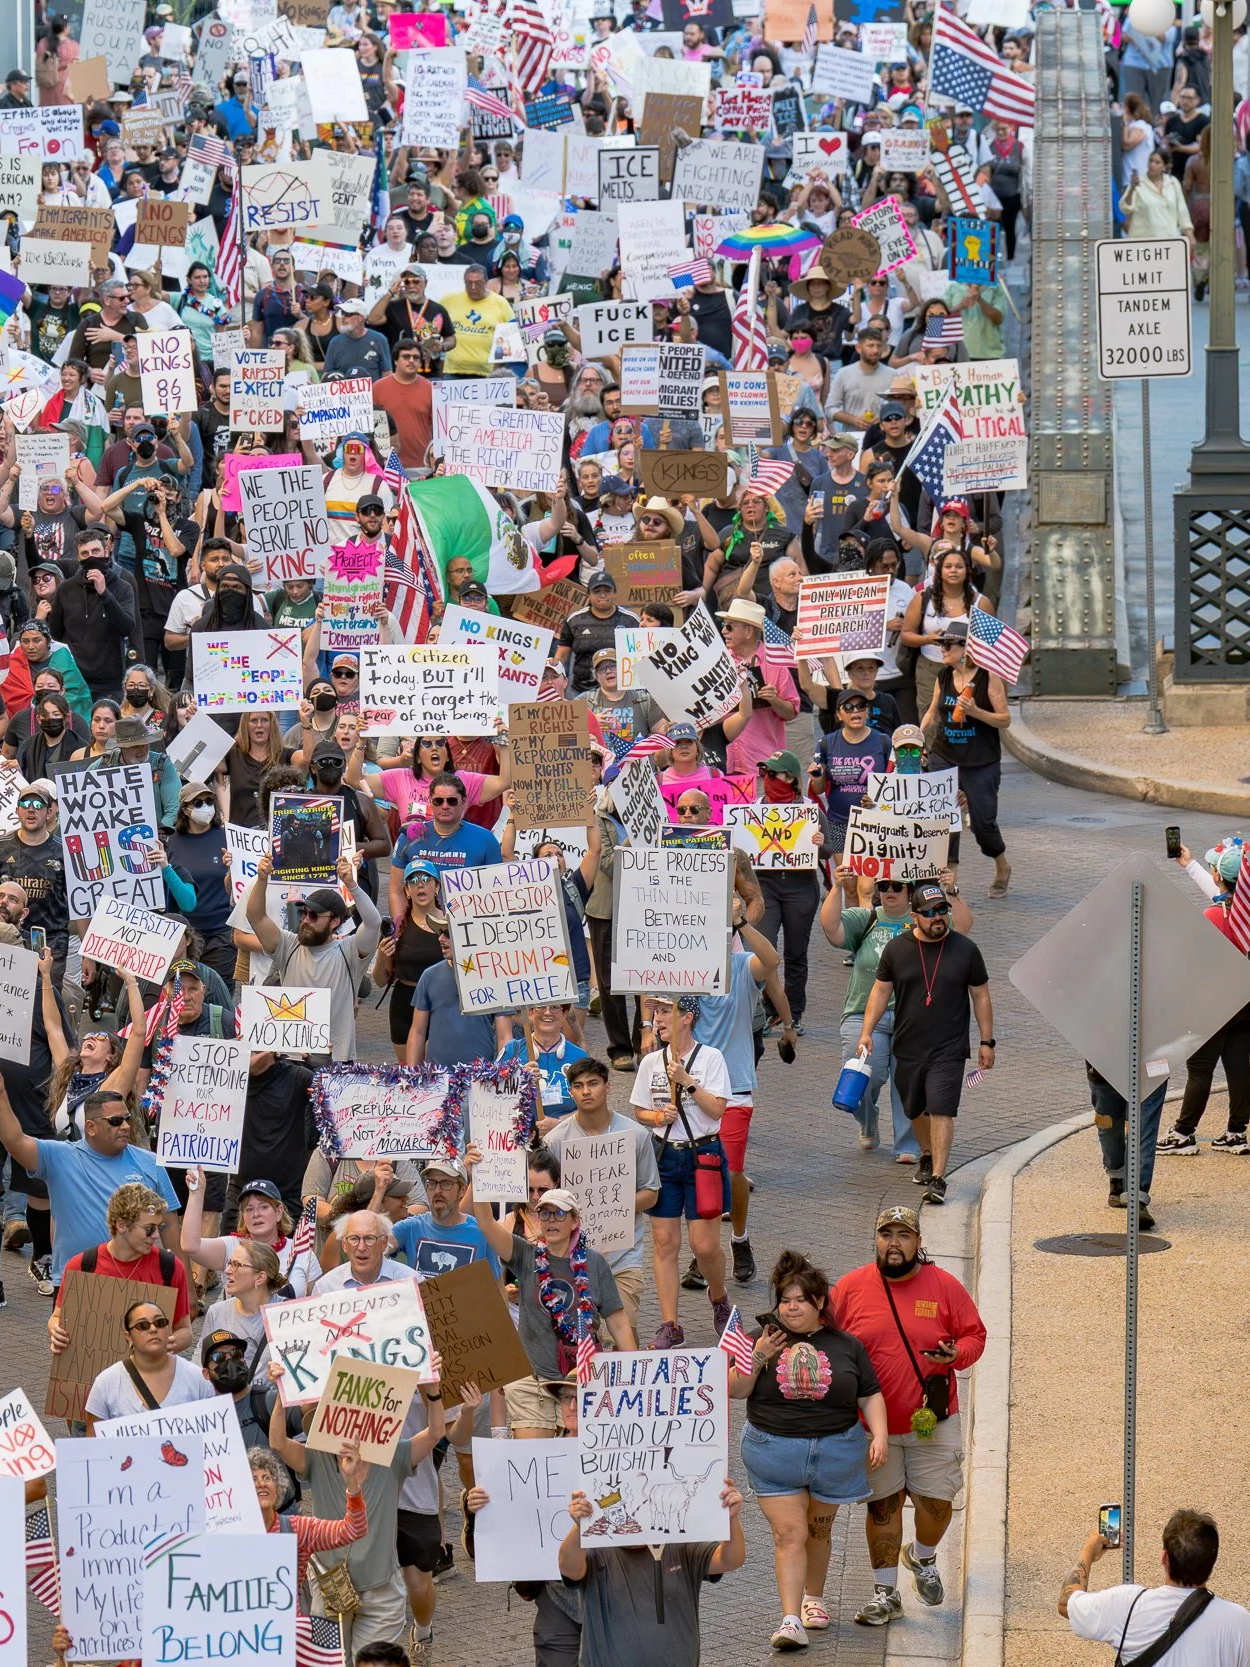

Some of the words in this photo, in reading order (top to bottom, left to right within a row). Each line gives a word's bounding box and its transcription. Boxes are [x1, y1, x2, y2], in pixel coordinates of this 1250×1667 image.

[9, 156, 20, 170] IS
[709, 147, 728, 160] WE
[733, 148, 759, 164] ARE
[610, 156, 653, 179] ICE
[602, 181, 634, 200] MELTS
[248, 199, 320, 227] RESIST
[1113, 248, 1171, 262] WEIGHT
[1122, 271, 1162, 285] LIMIT
[594, 305, 648, 324] FUCK
[1118, 298, 1171, 313] TANDEM
[599, 327, 635, 341] ICE
[1127, 323, 1161, 336] AXLE
[150, 337, 180, 354] NO
[140, 354, 191, 374] KINGS
[235, 352, 267, 364] VOTE
[1105, 347, 1161, 365] 32000
[1167, 350, 1184, 362] LBS
[240, 366, 283, 379] RAPIST
[158, 379, 181, 397] 86
[234, 380, 283, 397] EXPECT
[728, 381, 740, 389] NO
[743, 381, 766, 389] CONS
[158, 396, 181, 411] 47
[454, 407, 483, 425] THE
[489, 408, 562, 434] GREATNESS
[450, 426, 471, 442] OF
[474, 429, 532, 450] AMERICA
[543, 434, 558, 450] IS
[477, 450, 521, 468] RIGHT
[534, 454, 551, 470] TO
[242, 476, 268, 499] WE
[278, 469, 312, 492] THE
[252, 500, 316, 519] PEOPLE
[249, 522, 296, 554] SERVE
[303, 519, 328, 545] NO
[267, 548, 316, 579] KING
[811, 587, 839, 603] ONLY
[842, 586, 857, 600] WE
[855, 586, 877, 597] CAN
[820, 603, 866, 617] PREVENT
[812, 619, 870, 636] OLIGARCHY
[395, 653, 405, 664] a
[423, 669, 453, 684] BUT
[365, 692, 409, 706] never
[421, 692, 474, 710] forget
[476, 692, 498, 706] the
[400, 709, 415, 722] of
[422, 711, 449, 722] not
[453, 708, 491, 728] being
[62, 766, 142, 794] HATE
[62, 784, 144, 814] WON'T
[64, 807, 145, 834] MAKE
[65, 825, 158, 882] US
[622, 850, 658, 870] DUE
[667, 851, 726, 872] PROCESS
[445, 867, 487, 892] NOT
[492, 876, 502, 887] A
[508, 860, 551, 883] PAID
[649, 875, 658, 885] IS
[670, 875, 692, 886] THE
[460, 886, 556, 916] PROTESTOR
[458, 922, 477, 946] I
[482, 917, 557, 945] DESPISE
[627, 930, 708, 950] FREEDOM
[477, 947, 554, 978] FRUMP
[652, 954, 676, 963] AND
[470, 988, 497, 1006] FOR
[249, 1023, 277, 1046] NO
[282, 1023, 329, 1048] KINGS
[188, 1043, 239, 1066] STOP
[174, 1101, 230, 1121] RACISM
[197, 1123, 204, 1133] IS
[162, 1133, 238, 1161] PATRIOTISM
[333, 1371, 385, 1408] TANKS
[383, 1388, 402, 1412] for
[583, 1385, 714, 1418] FAMILIES
[319, 1405, 401, 1445] NOTHING!
[583, 1423, 643, 1448] STAND
[652, 1419, 681, 1445] UP
[691, 1419, 715, 1442] TO
[155, 1620, 282, 1662] BELONG
